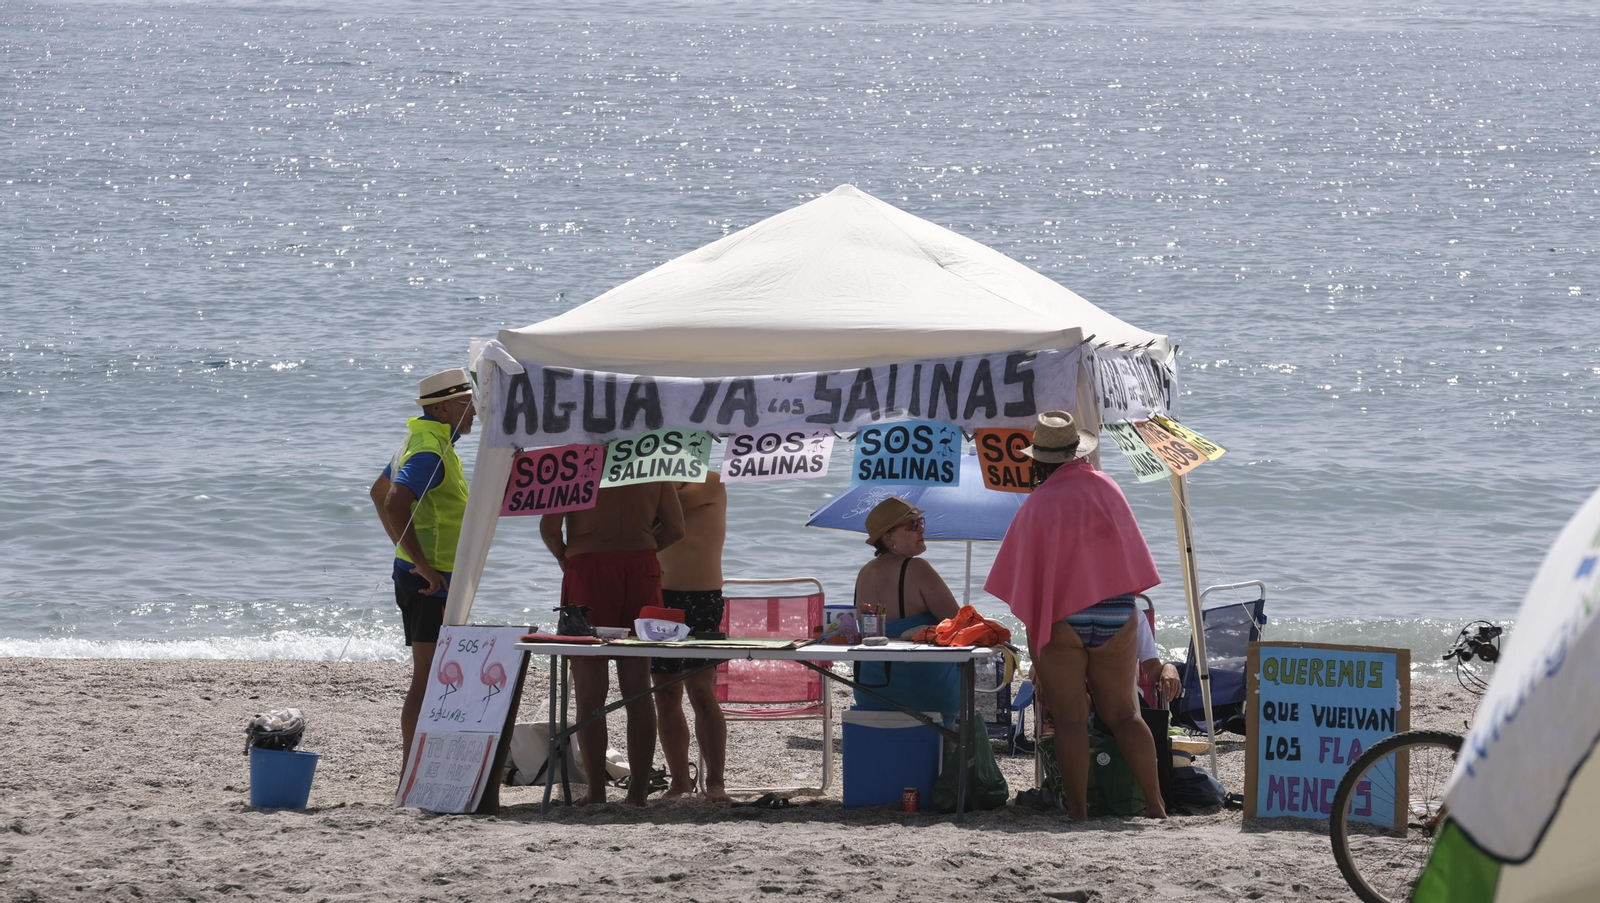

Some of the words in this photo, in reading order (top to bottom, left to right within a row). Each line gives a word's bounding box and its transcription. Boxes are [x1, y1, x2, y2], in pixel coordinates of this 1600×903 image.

[502, 365, 664, 436] AGUA
[768, 398, 805, 415] LAS
[805, 352, 1038, 425] SALINAS
[612, 430, 683, 462] SOS
[732, 432, 805, 456] SOS
[861, 425, 934, 455] SOS
[982, 432, 1033, 463] SO
[515, 450, 580, 488] SOS
[608, 457, 702, 483] SALINAS
[728, 454, 823, 478] SALINAS
[858, 458, 954, 484] SALINAS
[987, 464, 1037, 488] SALI
[508, 480, 595, 512] SALINAS
[458, 639, 480, 653] SOS
[1262, 657, 1384, 689] QUEREMOS
[429, 708, 466, 723] SALINAS
[1263, 701, 1300, 725] QUE
[1311, 703, 1396, 732] VUELVAN
[1265, 735, 1302, 761] LOS
[1319, 736, 1363, 766] FLA
[1266, 774, 1373, 817] MENCS
